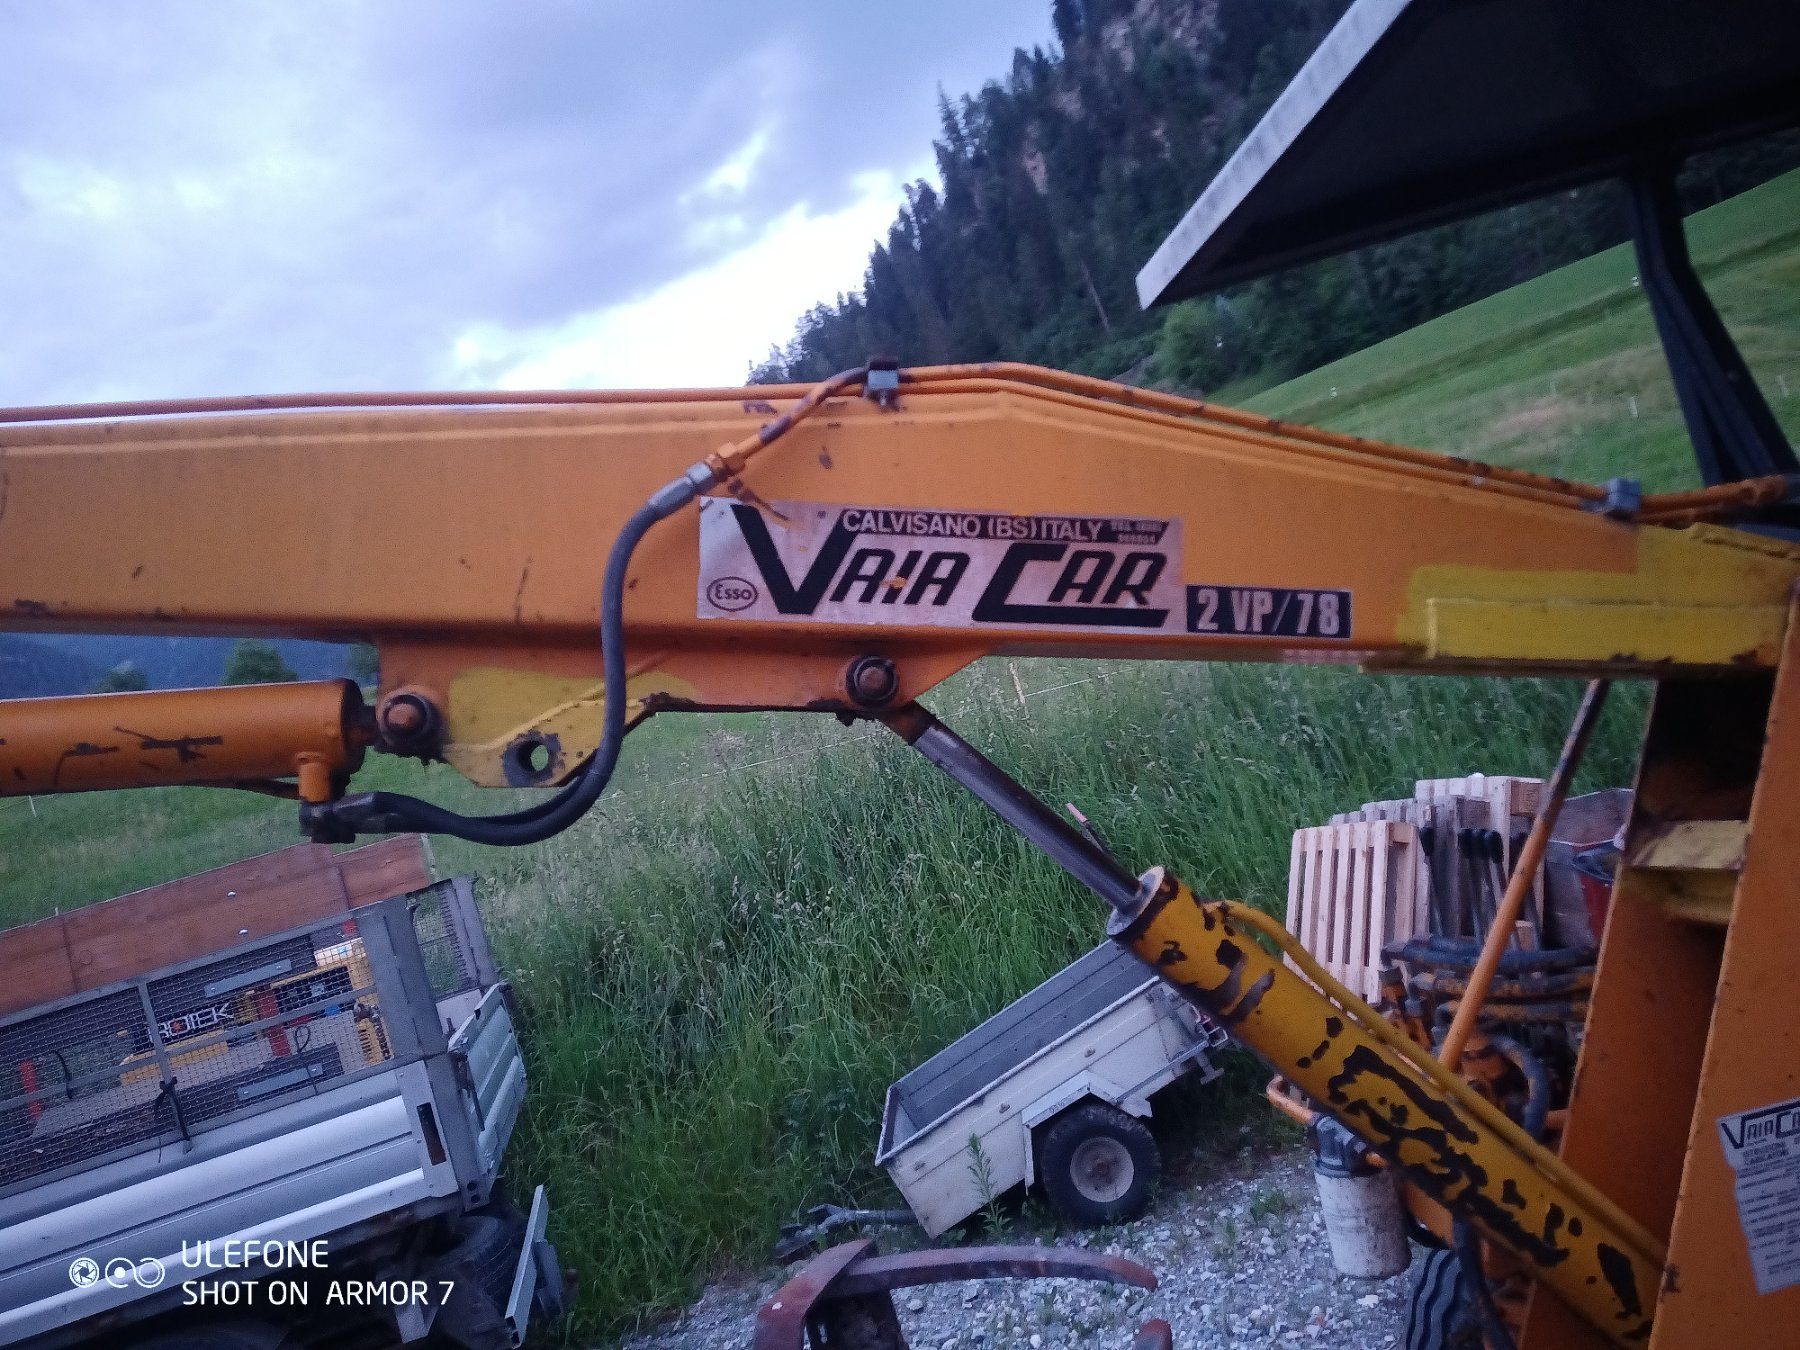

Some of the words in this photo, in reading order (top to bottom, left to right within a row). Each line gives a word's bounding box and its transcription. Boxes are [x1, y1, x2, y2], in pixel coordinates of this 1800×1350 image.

[842, 510, 982, 538] CALVISANO
[1041, 517, 1103, 542] ITALY
[729, 504, 970, 615] VAIA
[972, 542, 1170, 628] CAR
[1197, 588, 1219, 631] 2
